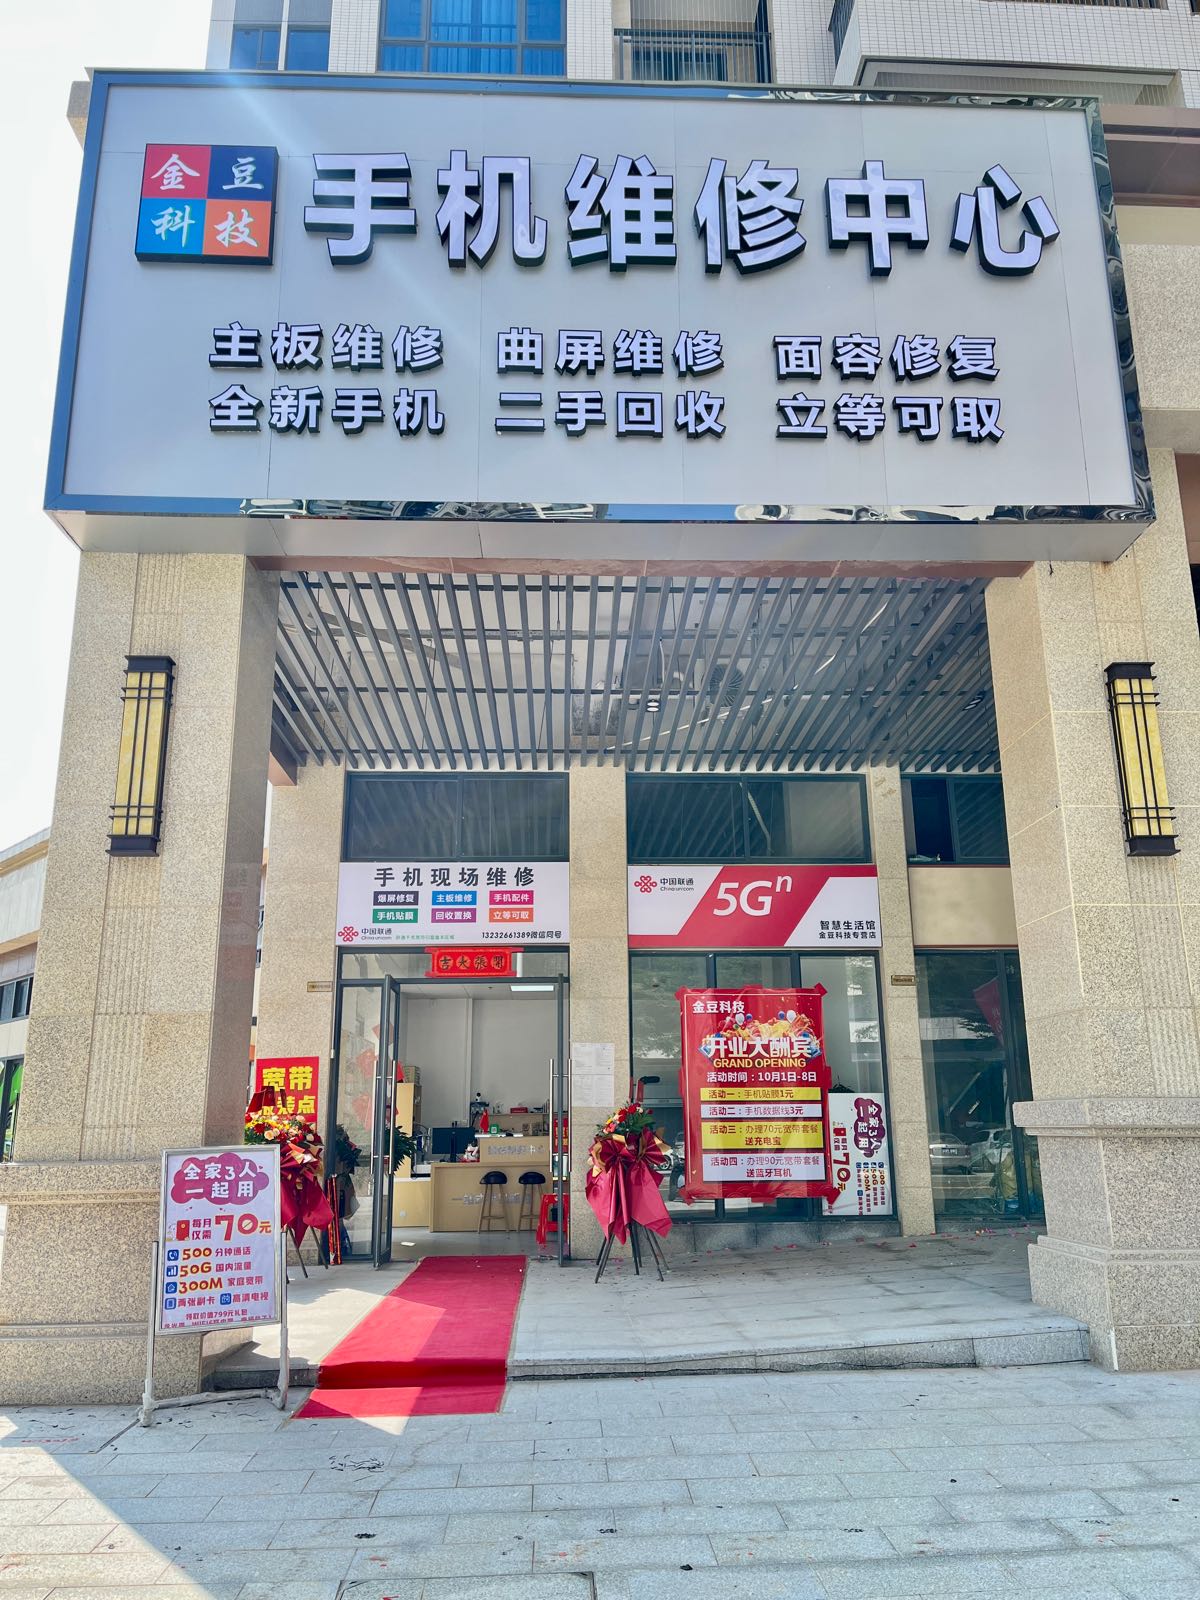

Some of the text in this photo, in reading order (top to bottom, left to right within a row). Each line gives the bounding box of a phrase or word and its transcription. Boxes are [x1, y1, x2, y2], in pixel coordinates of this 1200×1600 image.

[303, 148, 1060, 277] 手机维修中心
[149, 203, 262, 250] 科技
[208, 320, 1000, 382] 主板维修 曲屏维修 面容修复
[209, 383, 1004, 443] 全新手机 二手回收 立等可取
[373, 866, 535, 888] 手机现场维修
[660, 877, 694, 886] 中国联通
[377, 893, 530, 904] 爆屏修复 主板维修 手机配件
[376, 910, 530, 921] 手机贴膜 回收置换 立等可取
[361, 927, 392, 936] 中国联通
[819, 920, 876, 931] 智慧生活馆
[818, 931, 876, 940] 金豆科技专营店
[692, 1000, 745, 1014] 金豆科技
[708, 1036, 812, 1058] 开业大酬宾
[713, 1058, 807, 1068] GRAND OPENING
[262, 1065, 313, 1092] 宽带
[744, 1136, 782, 1146] 送充电宝
[183, 1160, 258, 1181] 全家3人
[746, 1168, 792, 1178] 送蓝牙耳机
[185, 1180, 254, 1199] 一起用
[192, 1218, 212, 1229] 每月
[191, 1229, 212, 1240] 仅需
[182, 1246, 251, 1260] 500 分钟通话
[179, 1262, 252, 1278] 50G 国内流量
[178, 1277, 223, 1294] 300M
